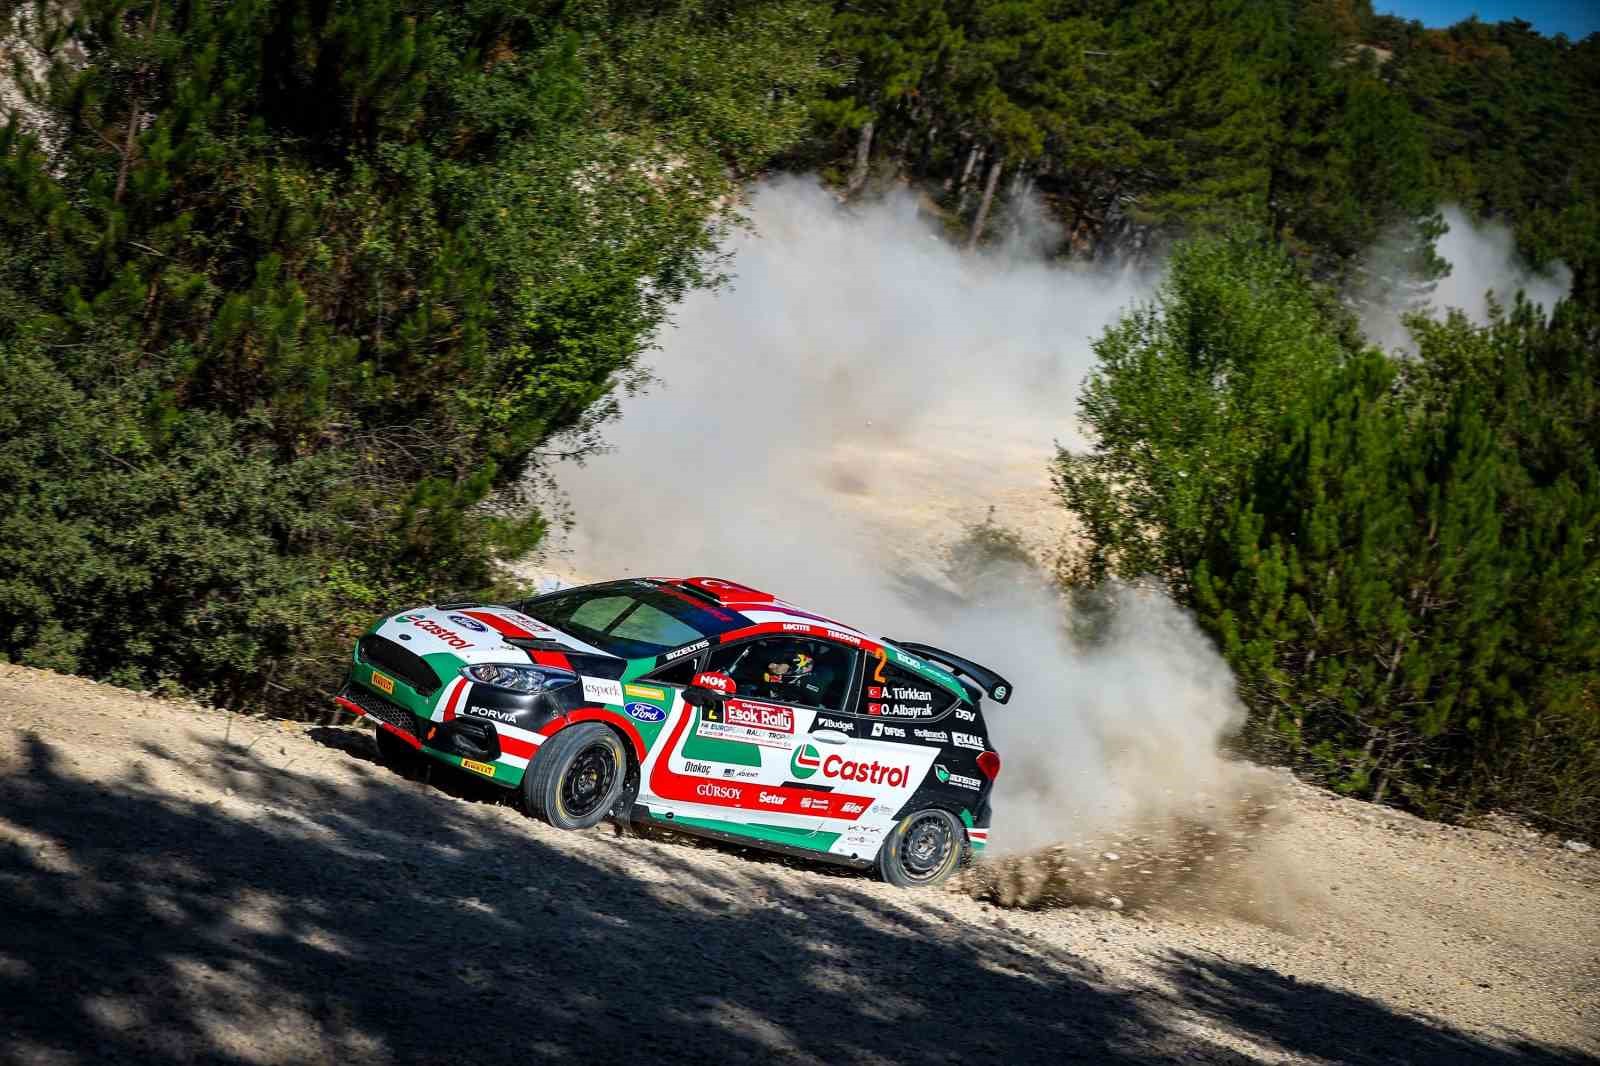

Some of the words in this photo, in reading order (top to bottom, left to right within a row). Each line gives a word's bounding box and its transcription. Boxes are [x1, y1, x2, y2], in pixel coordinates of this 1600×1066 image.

[413, 620, 476, 649] Castrol
[827, 630, 861, 644] TEROSON
[874, 647, 888, 683] 2
[374, 675, 392, 690] PIRELLI
[700, 675, 727, 690] NGK
[881, 687, 892, 698] A.
[893, 688, 932, 700] Türkkan
[470, 706, 517, 723] FORVIA
[631, 703, 658, 720] Ford
[728, 706, 758, 722] Esok
[761, 711, 791, 728] Rally
[892, 704, 933, 718] Albayrak
[955, 709, 976, 721] DSV
[828, 719, 855, 732] Budget
[884, 726, 906, 737] DFDS
[463, 760, 493, 775] PIRELLI
[684, 761, 712, 776] Otokoç
[823, 754, 910, 788] Castrol
[696, 784, 742, 799] GÜRSOY
[759, 791, 787, 805] Setur
